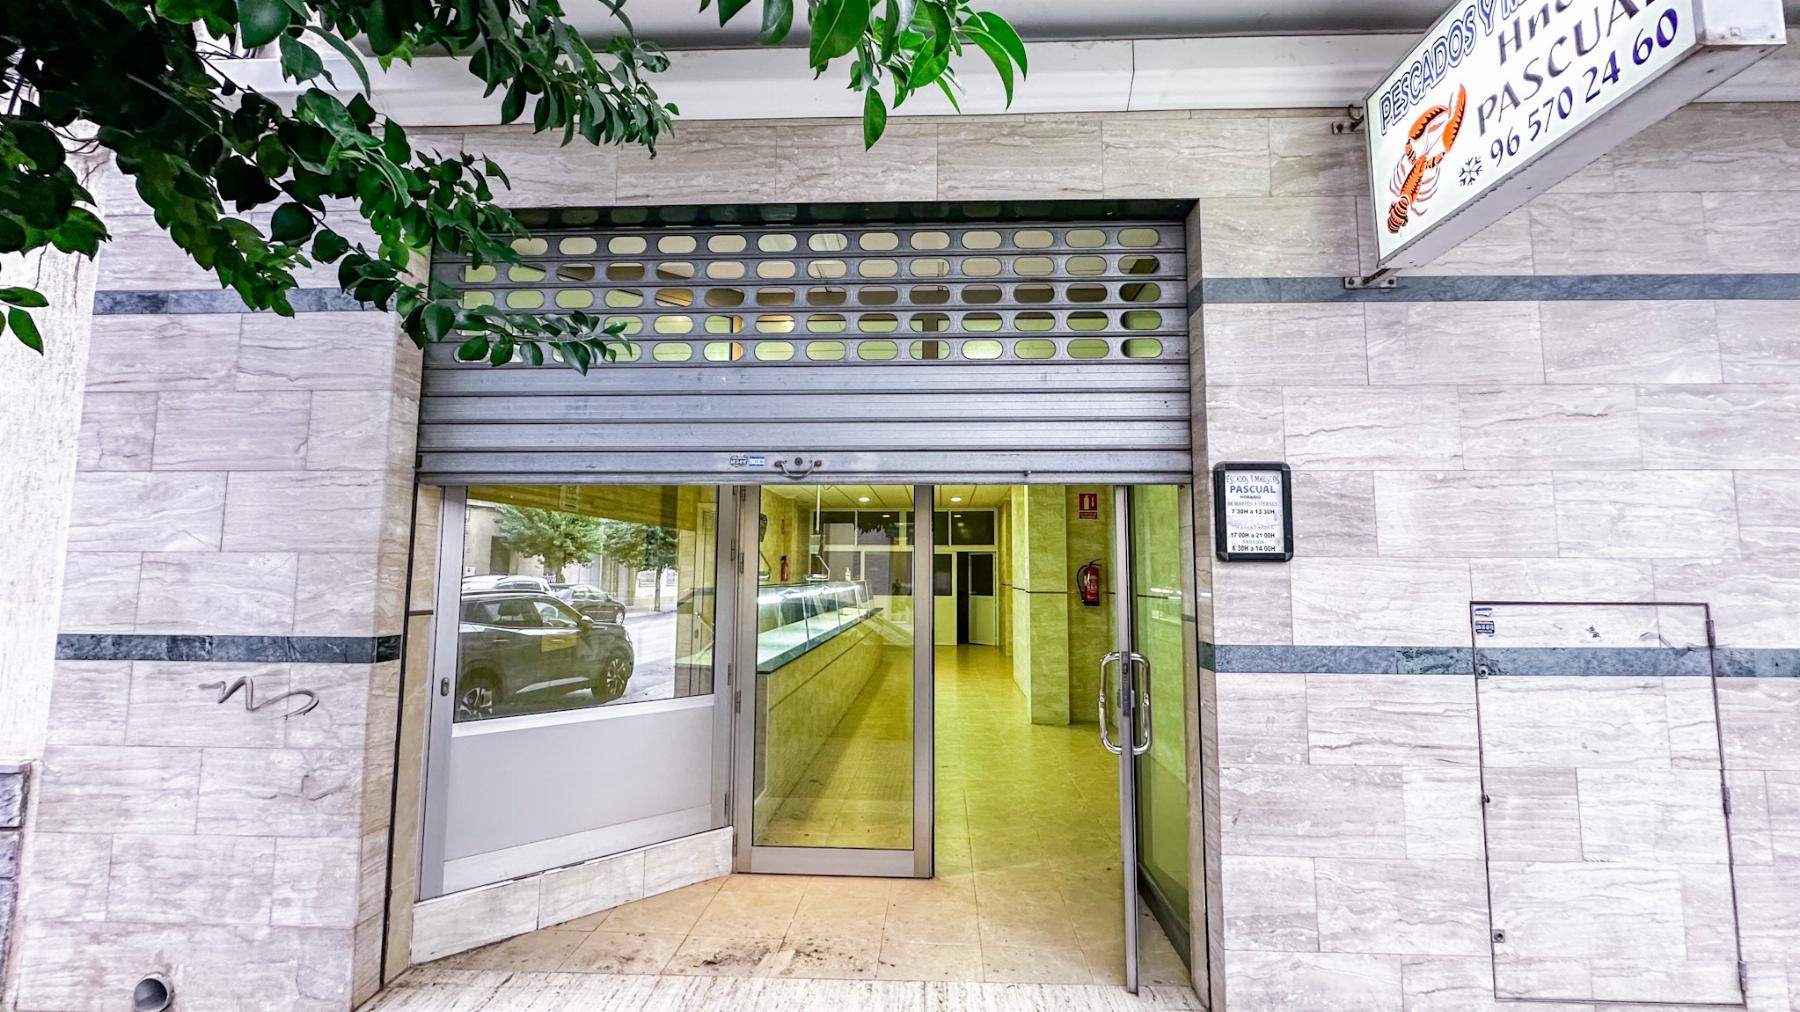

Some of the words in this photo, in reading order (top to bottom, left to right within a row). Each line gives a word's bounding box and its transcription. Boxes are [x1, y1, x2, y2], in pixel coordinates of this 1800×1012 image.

[1379, 4, 1477, 136] PESCADOS
[1478, 0, 1496, 37] Y
[1477, 0, 1656, 137] PASCUA
[1490, 126, 1520, 167] 96
[1528, 86, 1573, 141] 570
[1582, 50, 1620, 103] 24
[1632, 8, 1678, 65] 60
[1230, 485, 1276, 494] PASCUAL
